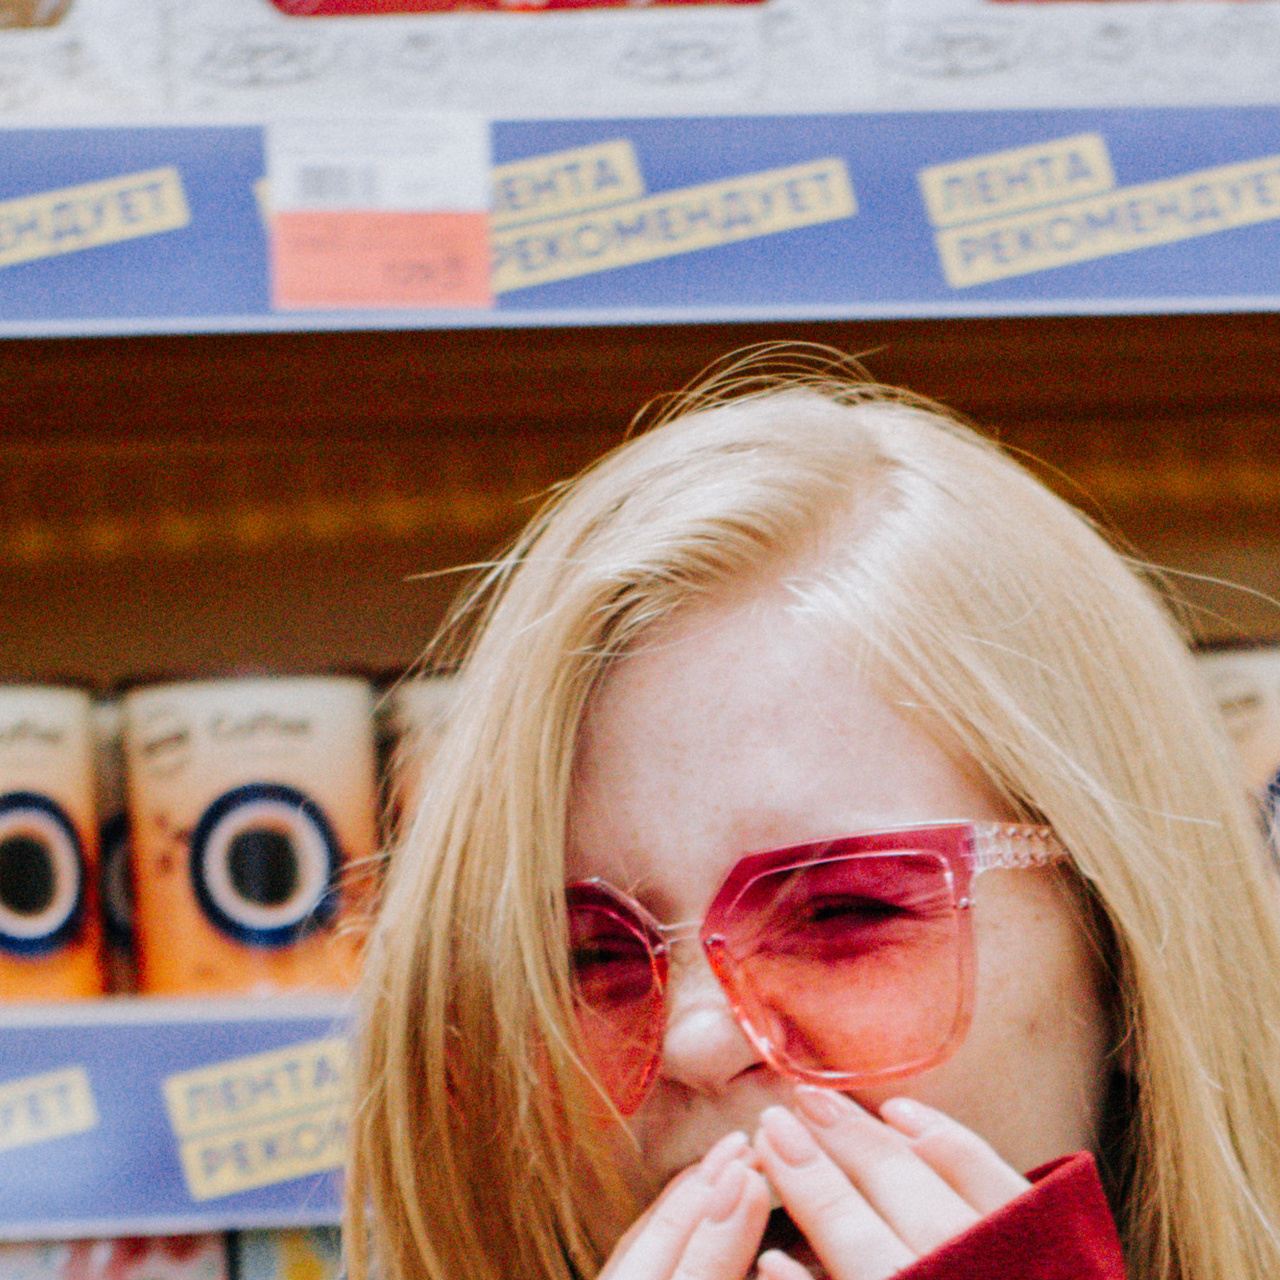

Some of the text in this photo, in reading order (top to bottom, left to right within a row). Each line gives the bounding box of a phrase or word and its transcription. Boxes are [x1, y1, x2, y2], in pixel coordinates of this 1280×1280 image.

[494, 155, 621, 213] ЕНТА
[941, 150, 1092, 212] ЛЕНТА
[185, 1054, 342, 1120] ЛЕНТА
